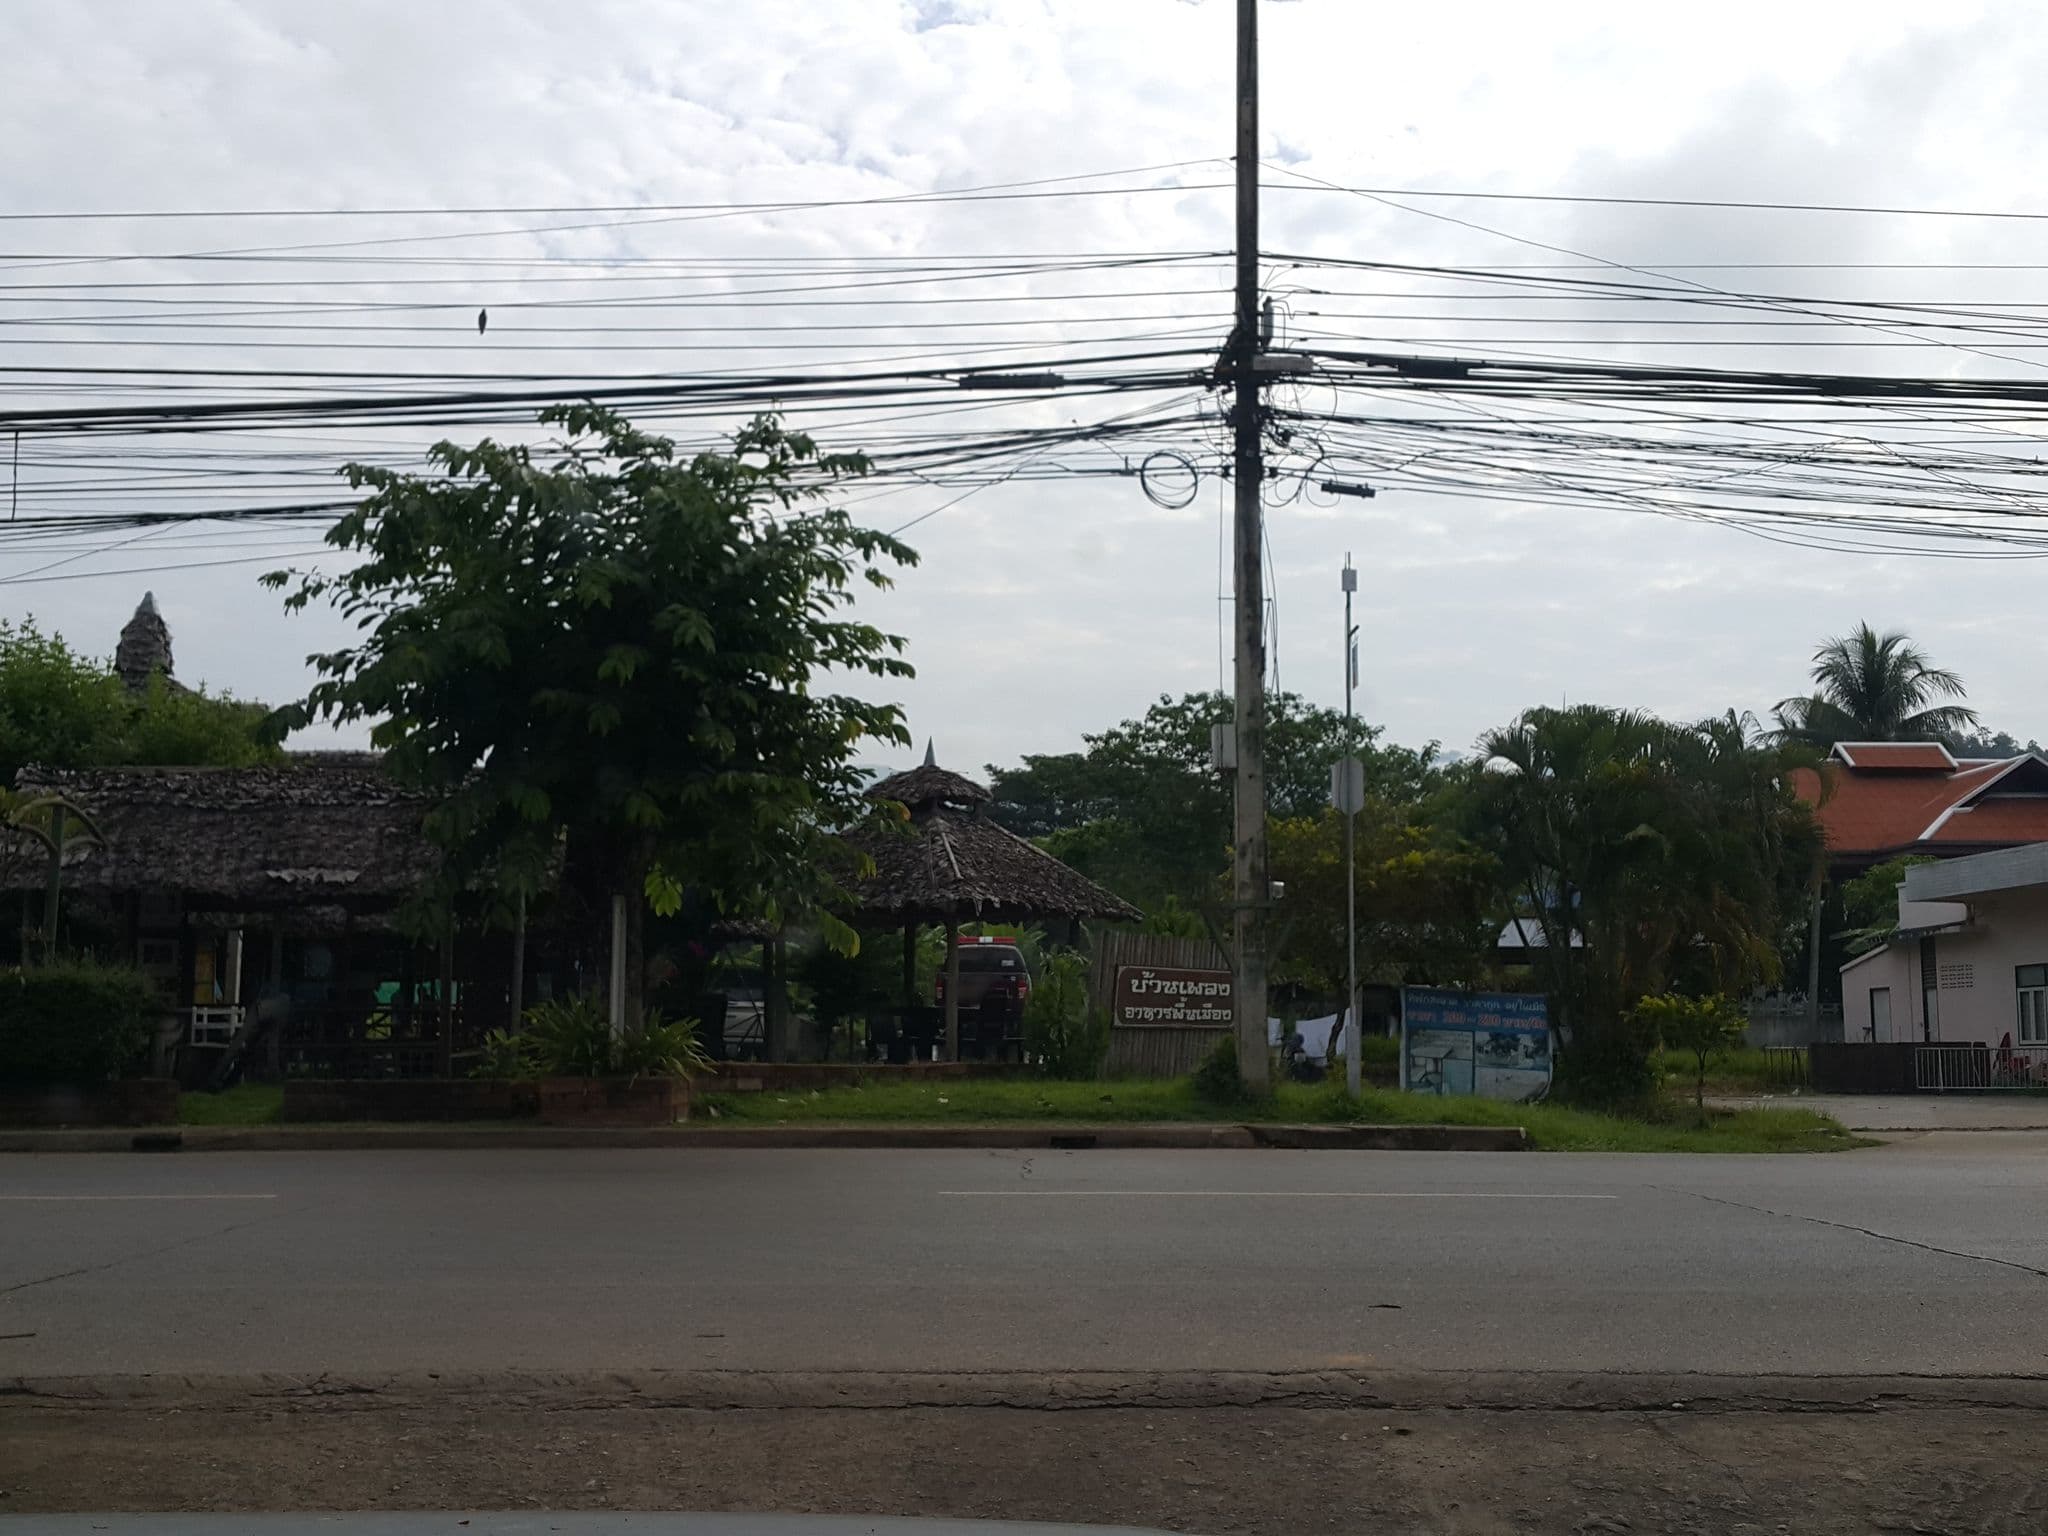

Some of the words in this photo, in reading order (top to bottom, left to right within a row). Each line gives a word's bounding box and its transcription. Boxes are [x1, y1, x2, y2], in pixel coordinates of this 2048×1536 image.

[1125, 997, 1232, 1021] อาหารพื้นเมือง
